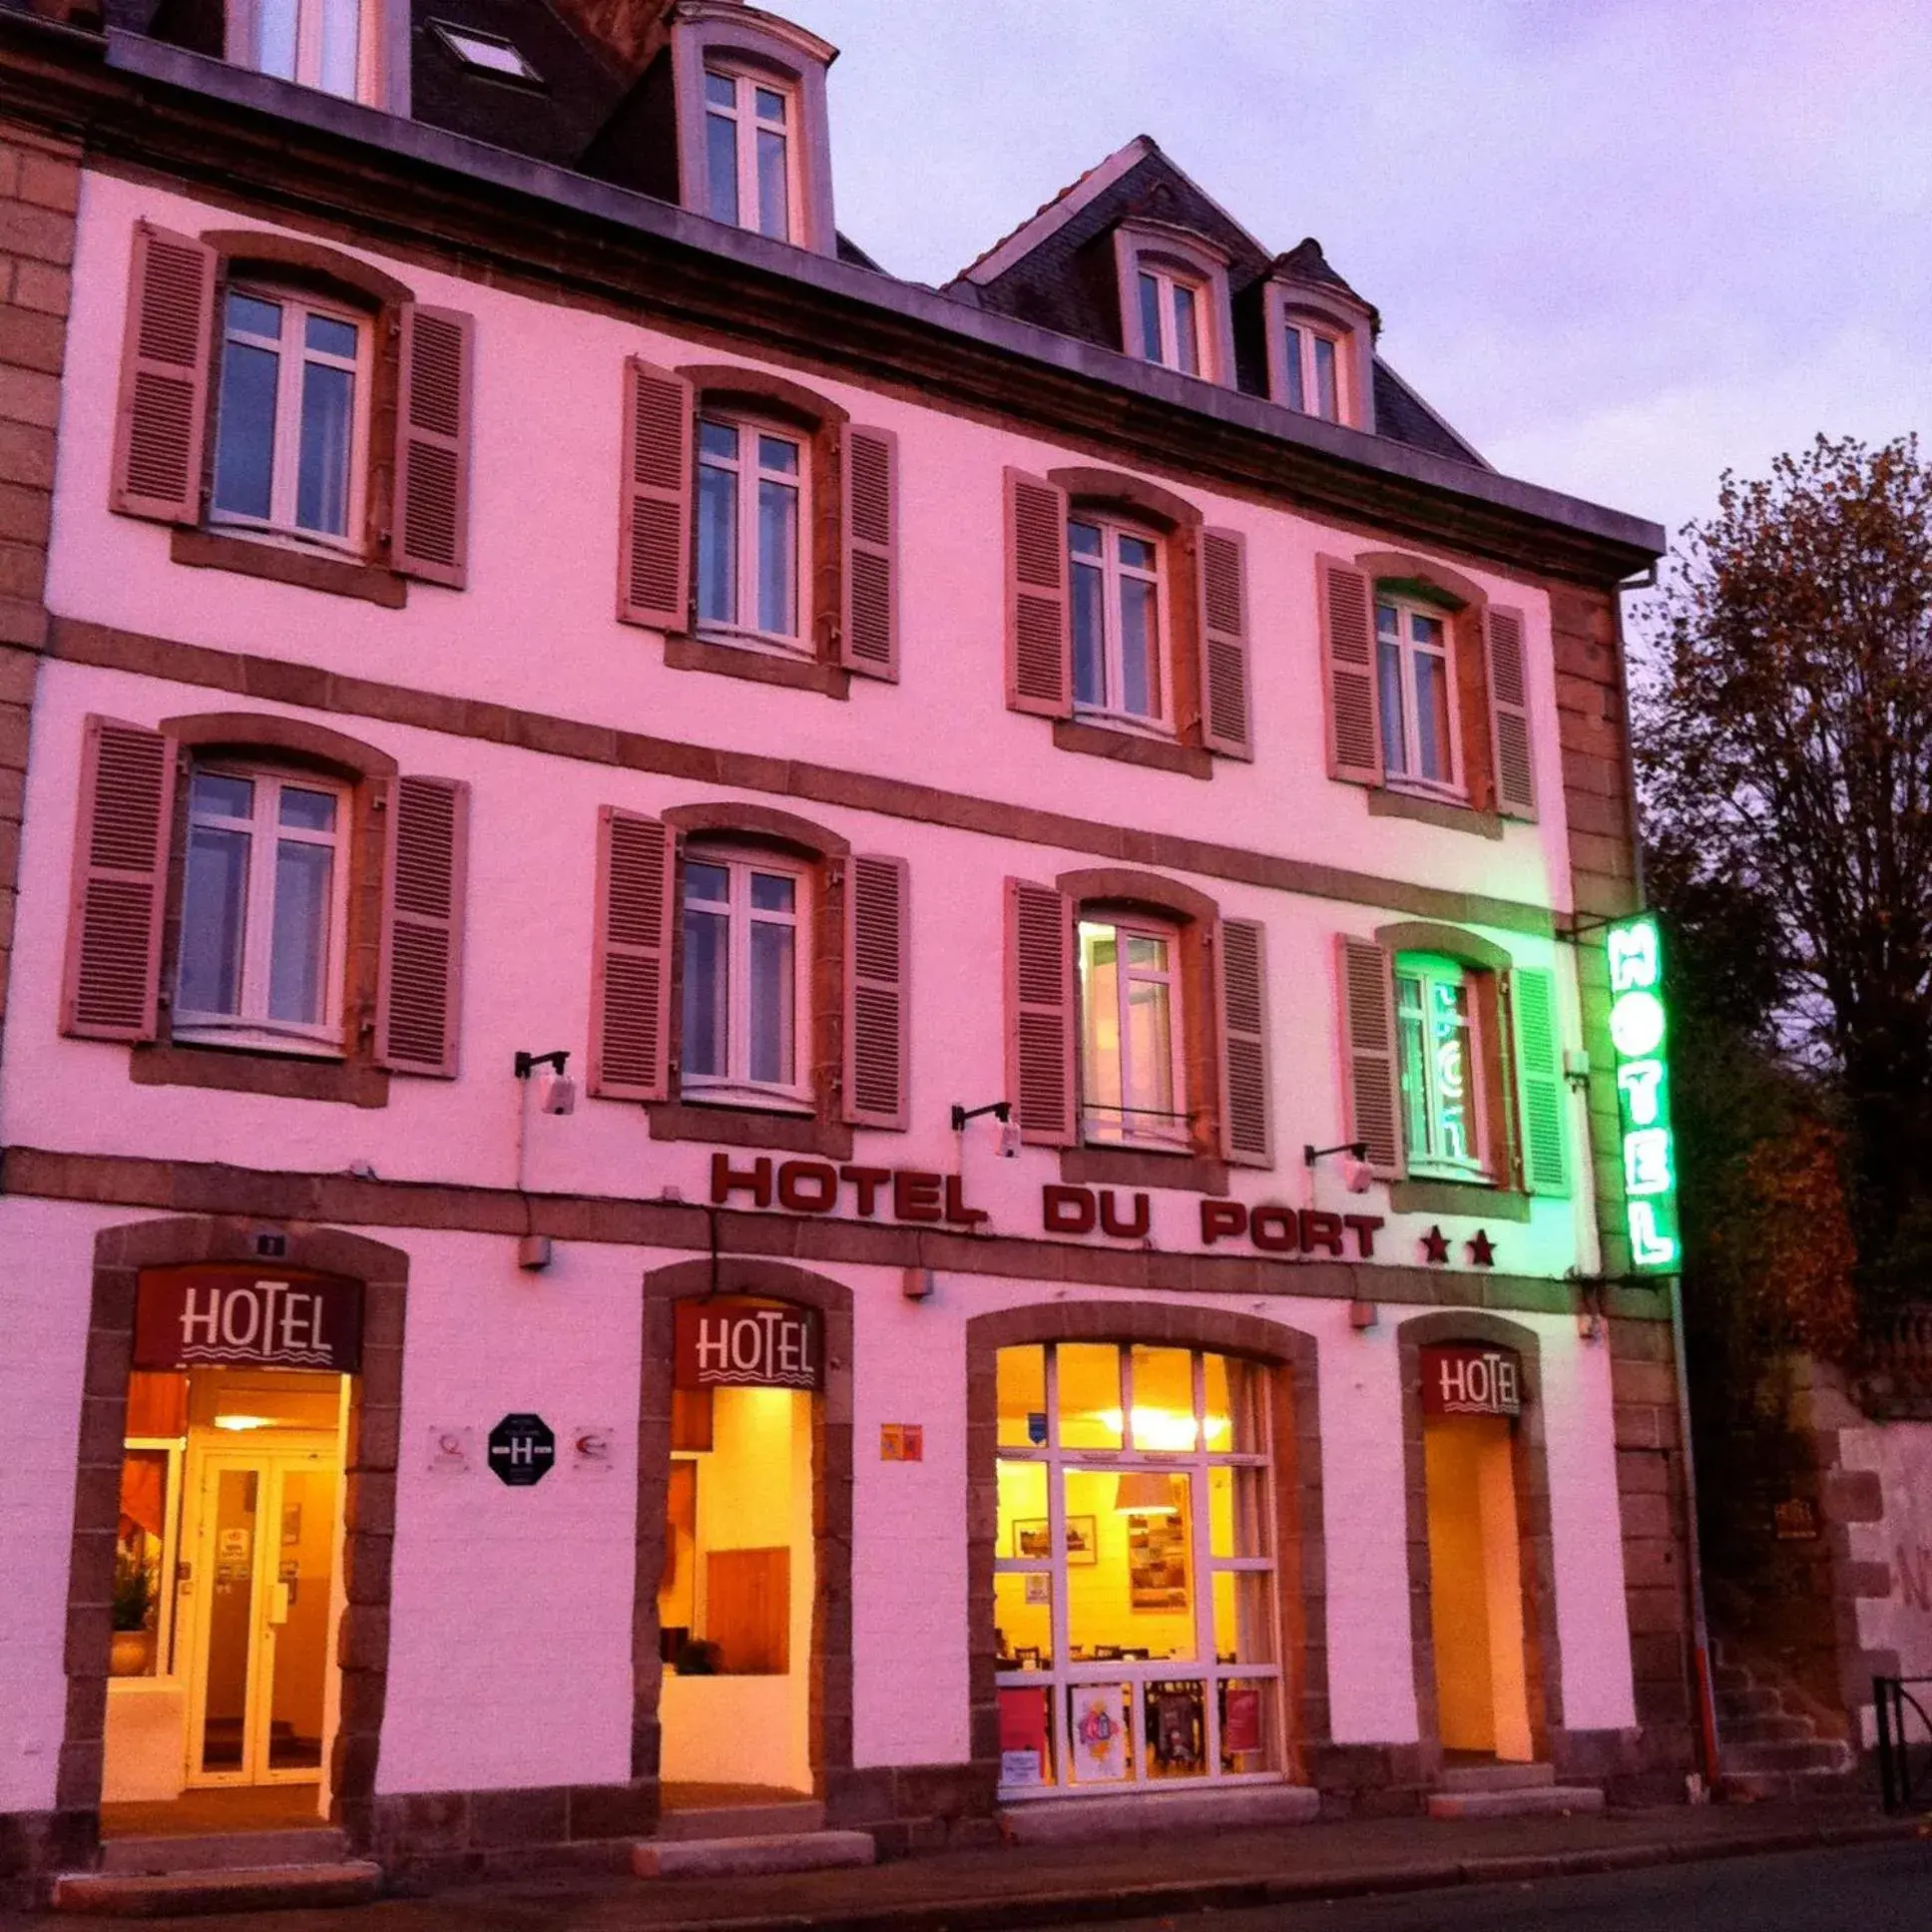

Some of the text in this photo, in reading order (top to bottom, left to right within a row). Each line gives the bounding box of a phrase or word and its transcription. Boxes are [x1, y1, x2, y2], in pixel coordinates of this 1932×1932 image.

[1608, 920, 1679, 1265] HOTEL
[711, 1153, 1384, 1258] HOTEL DU PORT
[180, 1281, 332, 1356] HOTEL
[696, 1311, 814, 1378] HOTEL
[1439, 1353, 1520, 1409] HOTEL
[511, 1437, 533, 1464] H
